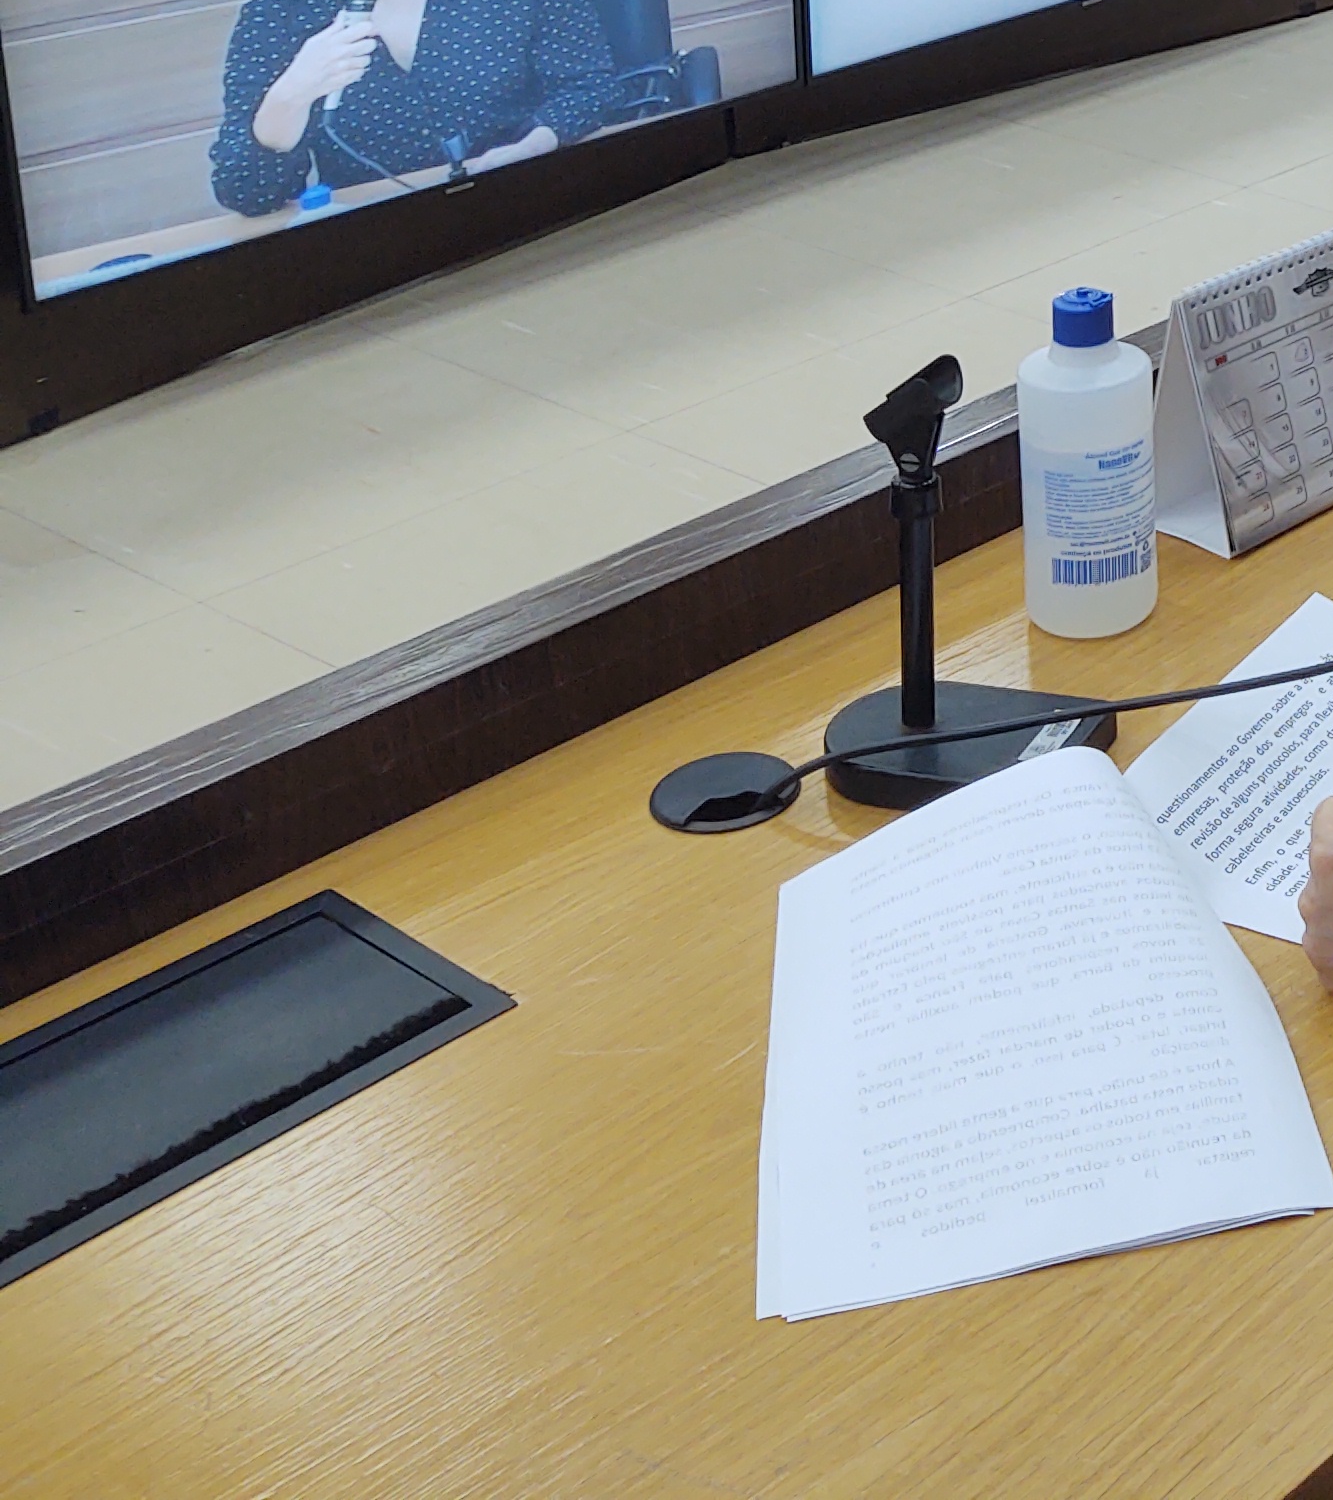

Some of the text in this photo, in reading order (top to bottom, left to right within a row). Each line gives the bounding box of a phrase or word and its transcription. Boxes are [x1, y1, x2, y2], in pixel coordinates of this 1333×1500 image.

[1197, 286, 1277, 350] JUNHO
[1155, 754, 1228, 824] questionamentos
[1225, 743, 1240, 757] ao
[1235, 711, 1273, 745] Governo
[1270, 690, 1296, 713] sobre
[1292, 683, 1303, 691] a
[1173, 795, 1219, 836] empresas,
[1217, 756, 1256, 795] proteção
[1255, 739, 1273, 756] dos
[1272, 699, 1314, 738] empregos
[1317, 686, 1327, 694] e
[1189, 817, 1223, 850] revisão
[1218, 806, 1235, 820] de
[1230, 780, 1260, 808] alguns
[1255, 739, 1304, 784] protocolos,
[1298, 720, 1320, 741] para
[1203, 834, 1235, 863] forma
[1232, 805, 1264, 836] segura
[1260, 764, 1307, 806] atividades,
[1303, 738, 1328, 763] como
[1223, 768, 1330, 874] cabelereiras e autoescolas.
[1243, 859, 1278, 885] Enfim,
[1275, 847, 1286, 856] o
[1284, 828, 1305, 846] que
[1265, 863, 1299, 892] cidade.
[1282, 877, 1304, 899] com
